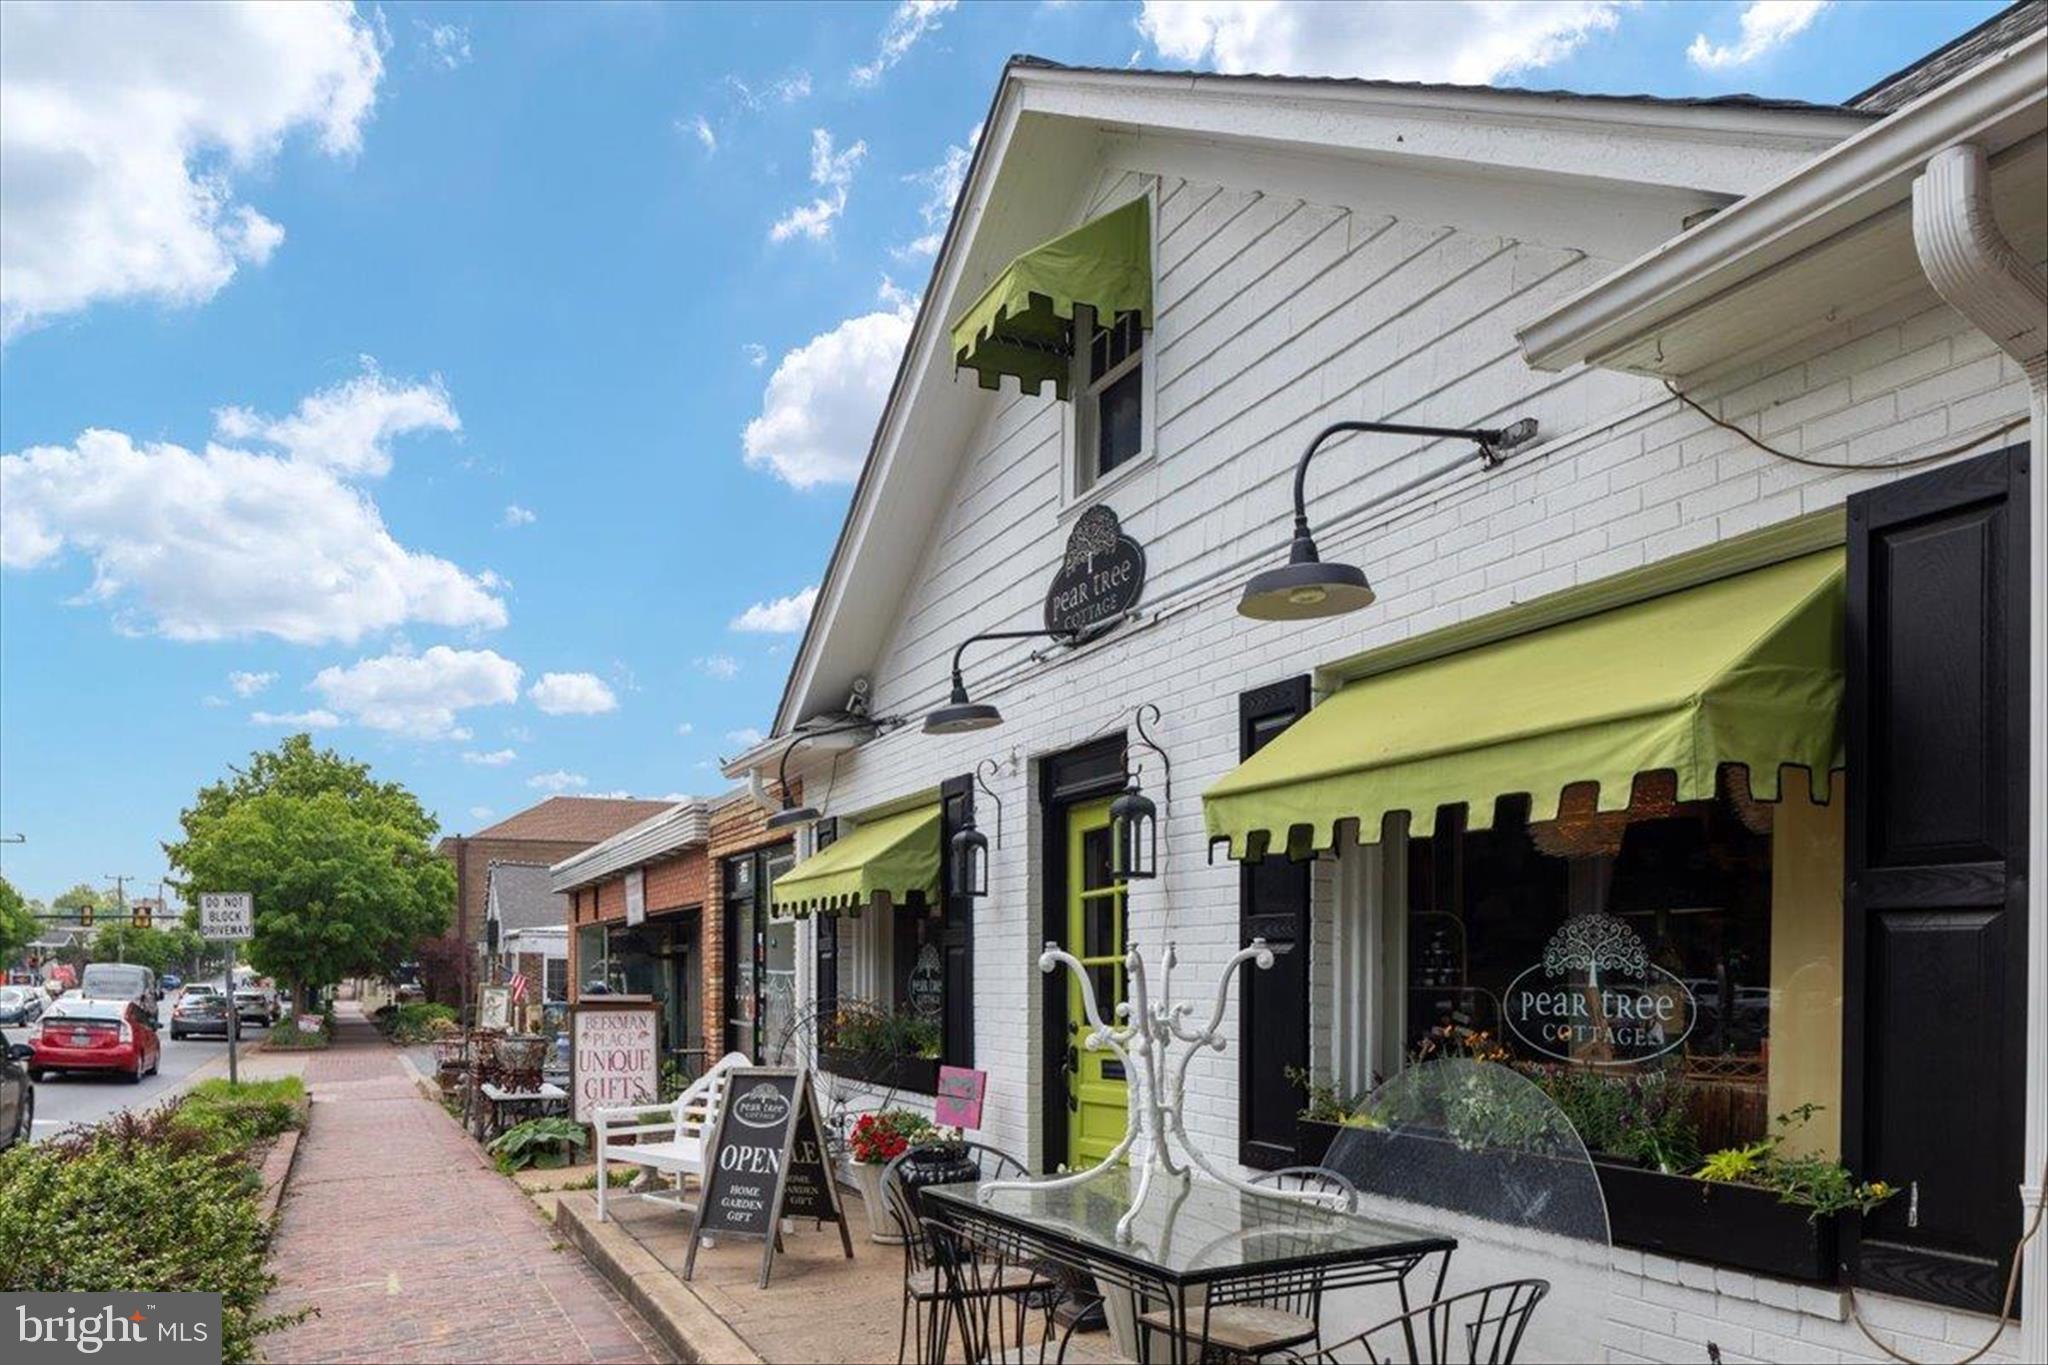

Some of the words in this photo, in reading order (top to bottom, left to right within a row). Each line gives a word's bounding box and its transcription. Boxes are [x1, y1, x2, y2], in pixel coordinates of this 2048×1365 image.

[1063, 594, 1119, 629] COTTAGE
[206, 896, 219, 908] DO
[224, 896, 243, 908] NOT
[209, 910, 241, 922] BLOCK
[201, 925, 250, 935] DRIVEWAY
[584, 1015, 648, 1030] BEEKMAN
[593, 1032, 637, 1047] PLACE
[1542, 1023, 1647, 1046] COTTAGE
[579, 1049, 652, 1073] UNIQUE
[584, 1077, 649, 1100] GIFTS
[720, 1144, 783, 1174] OPEN
[730, 1185, 760, 1197] HOME
[721, 1197, 763, 1210] GARDEN
[726, 1211, 752, 1222] GIFT
